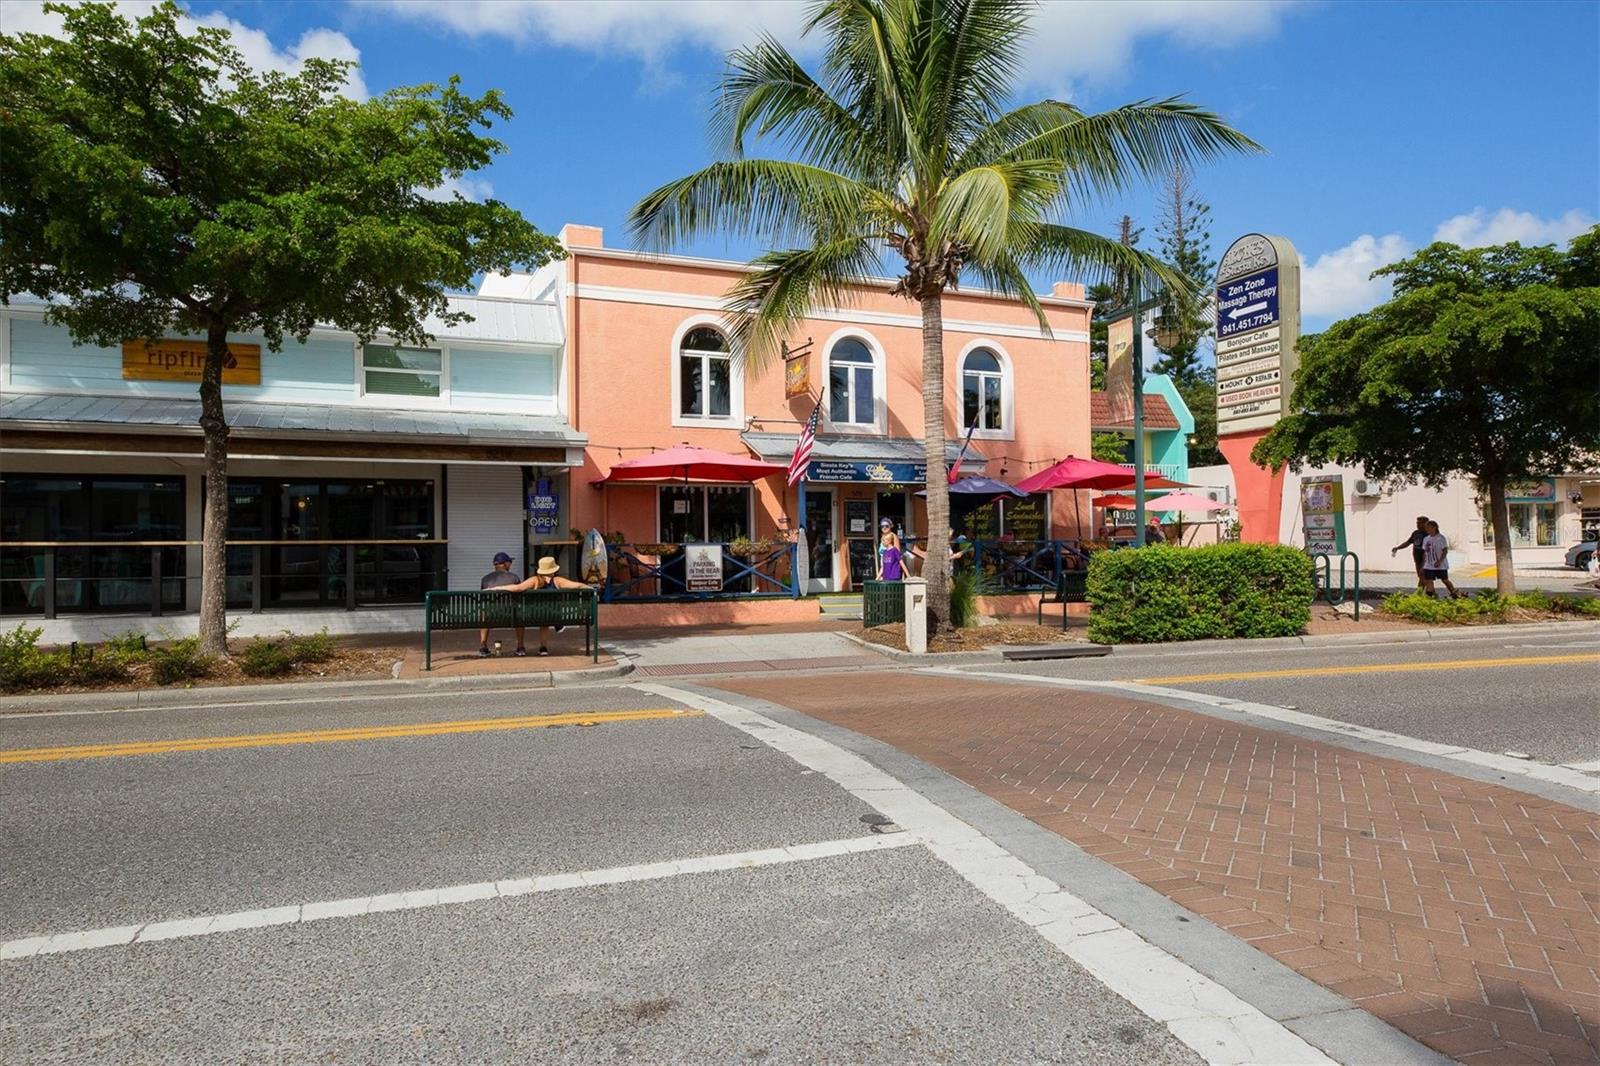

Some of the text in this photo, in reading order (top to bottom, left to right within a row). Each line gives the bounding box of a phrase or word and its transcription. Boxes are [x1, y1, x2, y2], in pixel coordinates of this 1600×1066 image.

[1228, 278, 1265, 297] Zen Zone
[1218, 285, 1277, 310] Massage Therapy
[1222, 312, 1273, 334] 941.451.7794
[1227, 331, 1268, 347] Bonjour Cafe
[1219, 343, 1278, 362] Pilates and Massage
[1225, 379, 1244, 389] MOUNT
[1255, 373, 1273, 382] REPAIR
[1225, 394, 1237, 403] USED
[1239, 390, 1252, 400] BOOK
[529, 517, 558, 527] OPEN
